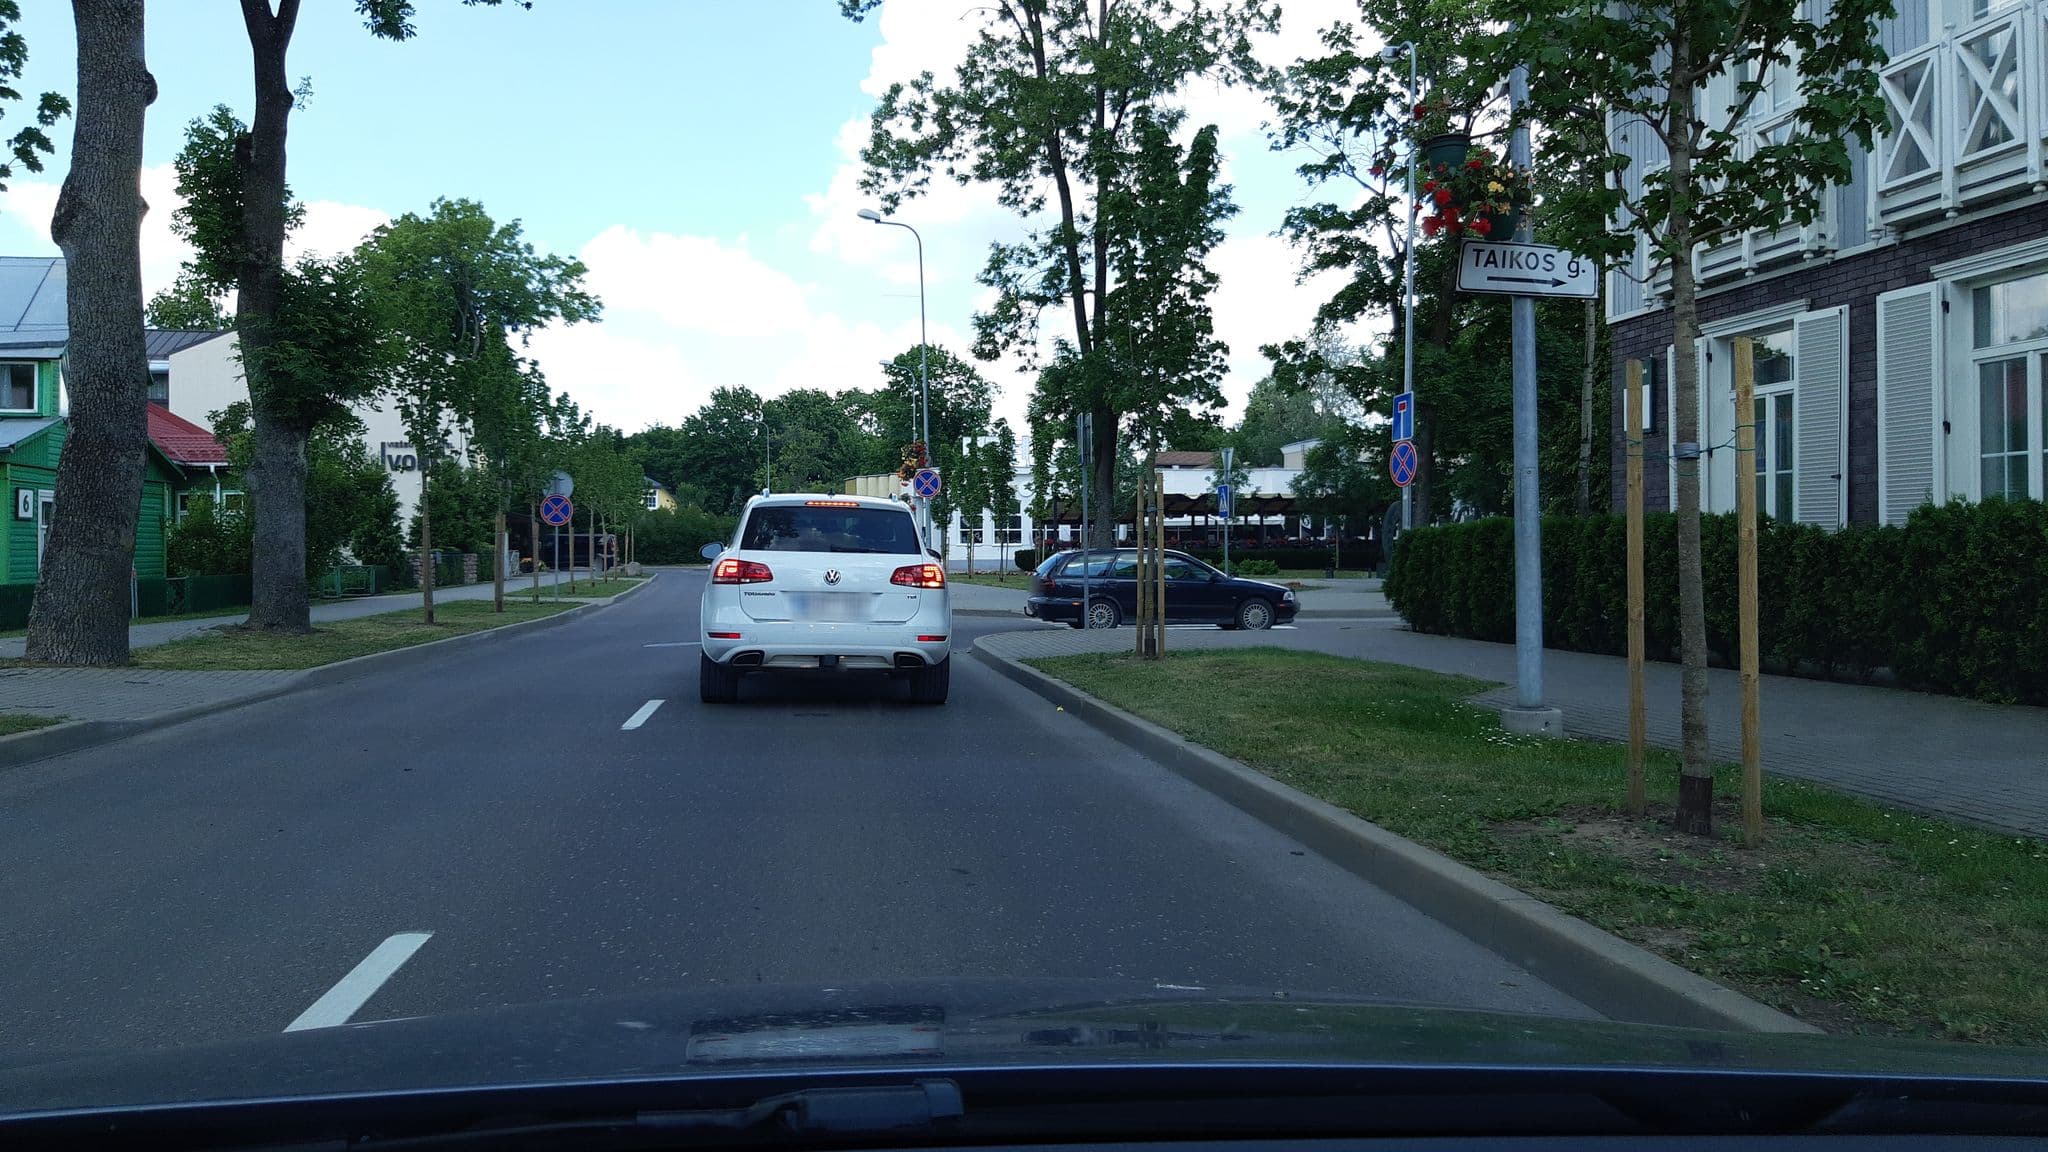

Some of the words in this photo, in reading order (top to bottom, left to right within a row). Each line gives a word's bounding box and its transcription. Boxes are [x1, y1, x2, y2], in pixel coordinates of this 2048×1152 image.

[1472, 248, 1556, 272] TAIKOS
[1567, 260, 1586, 279] g.
[22, 494, 30, 513] 6
